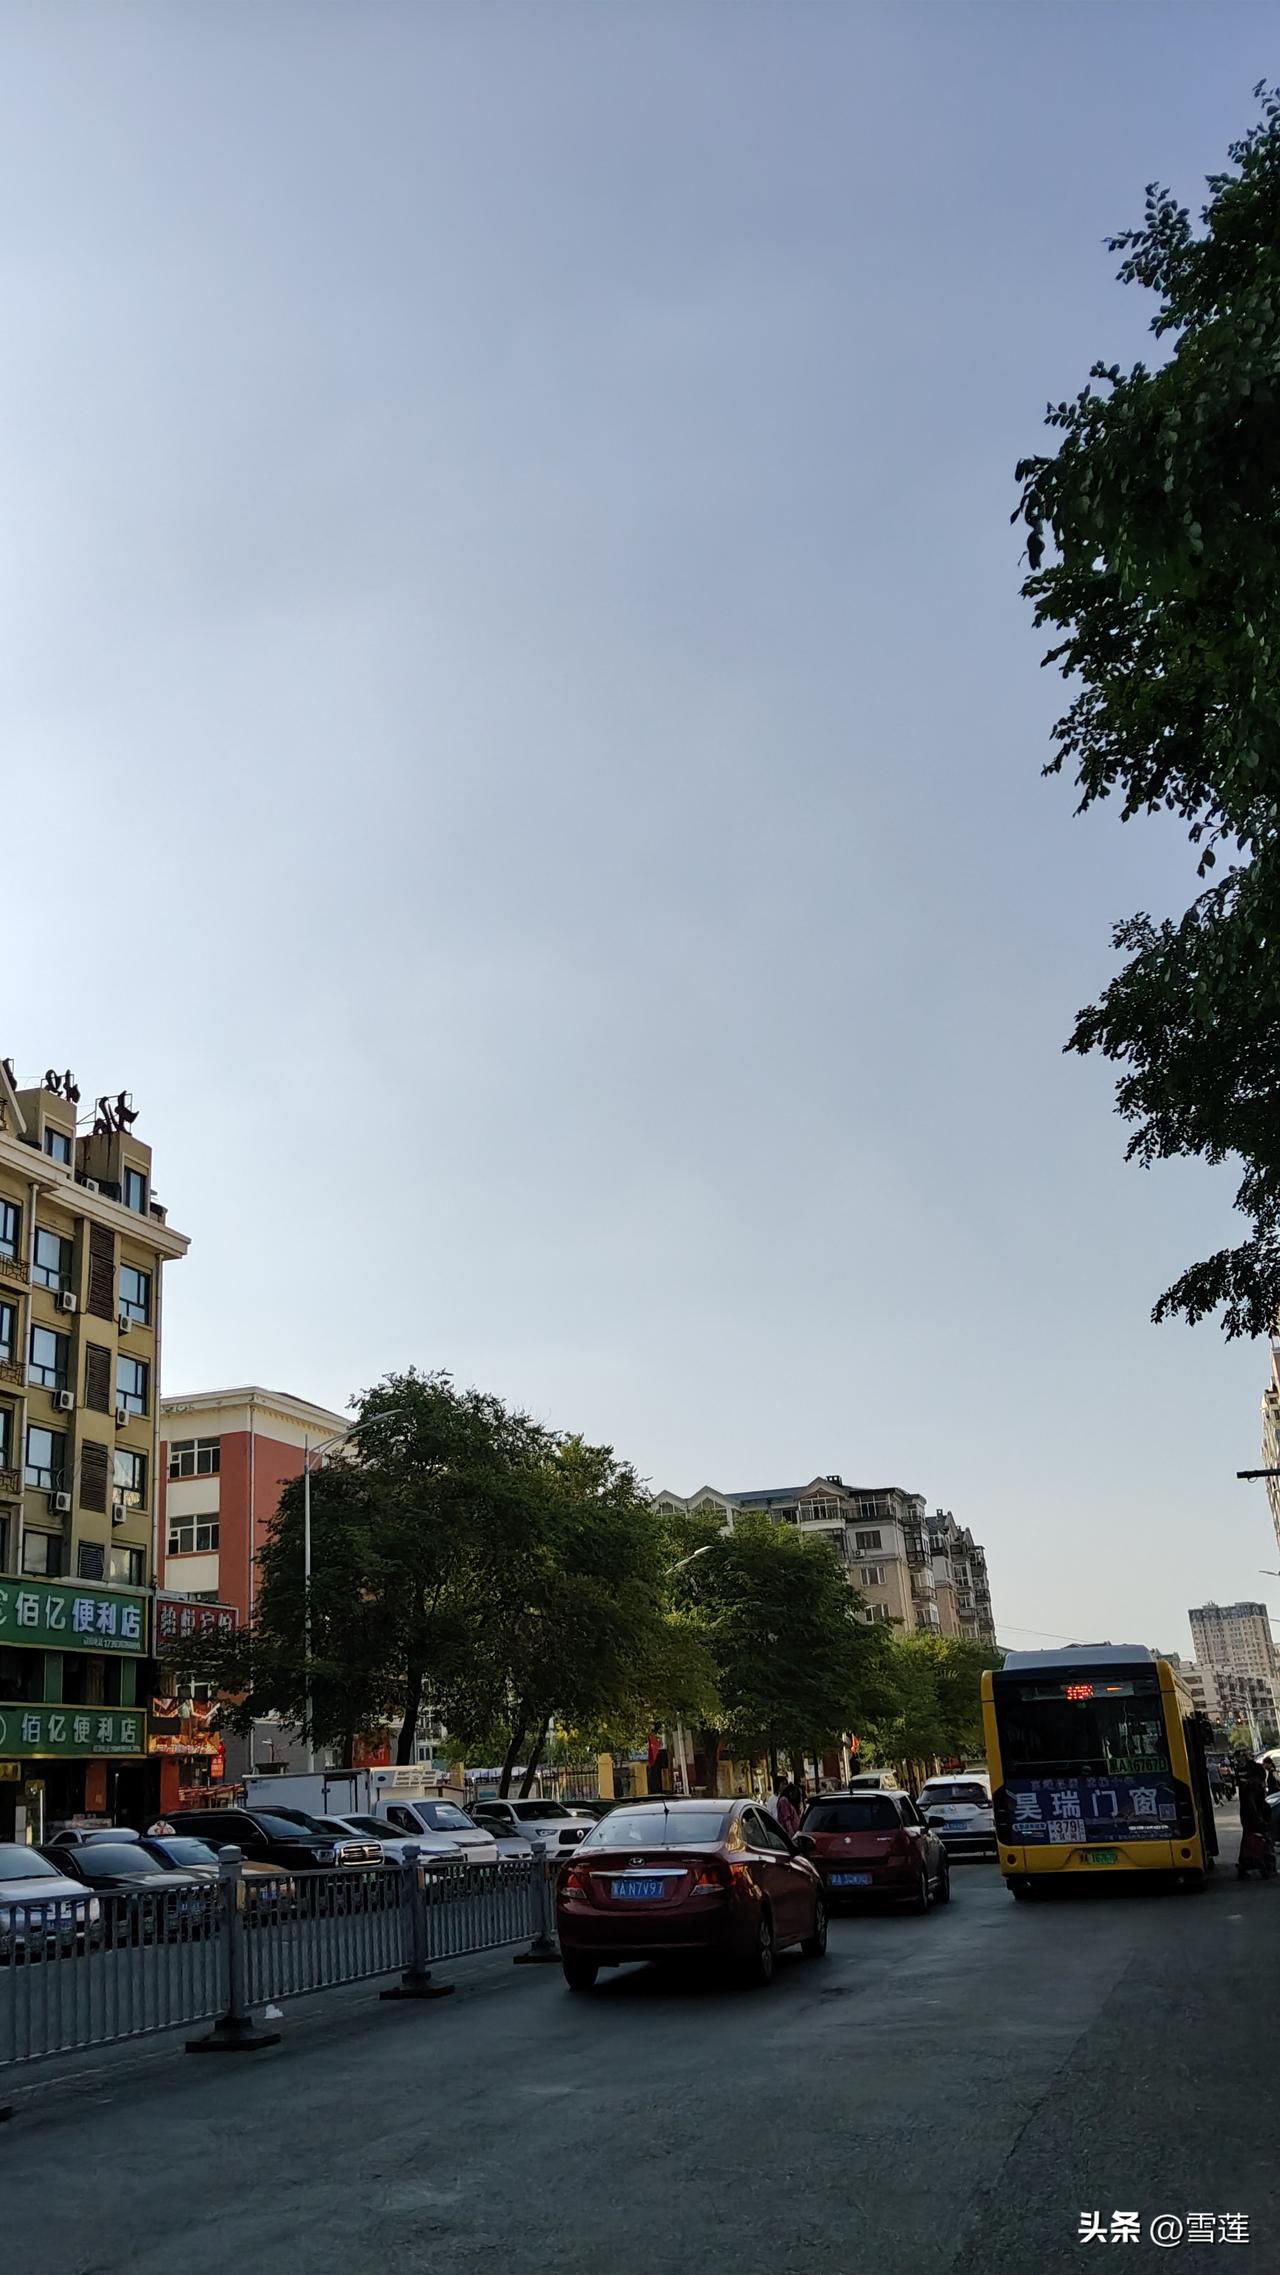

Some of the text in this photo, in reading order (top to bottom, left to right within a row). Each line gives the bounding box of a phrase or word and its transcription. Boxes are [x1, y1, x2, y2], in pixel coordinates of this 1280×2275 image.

[15, 1591, 141, 1637] 佰亿便利店
[21, 1712, 137, 1744] 佰亿便利店
[1014, 1786, 1158, 1821] 昊瑞门窗
